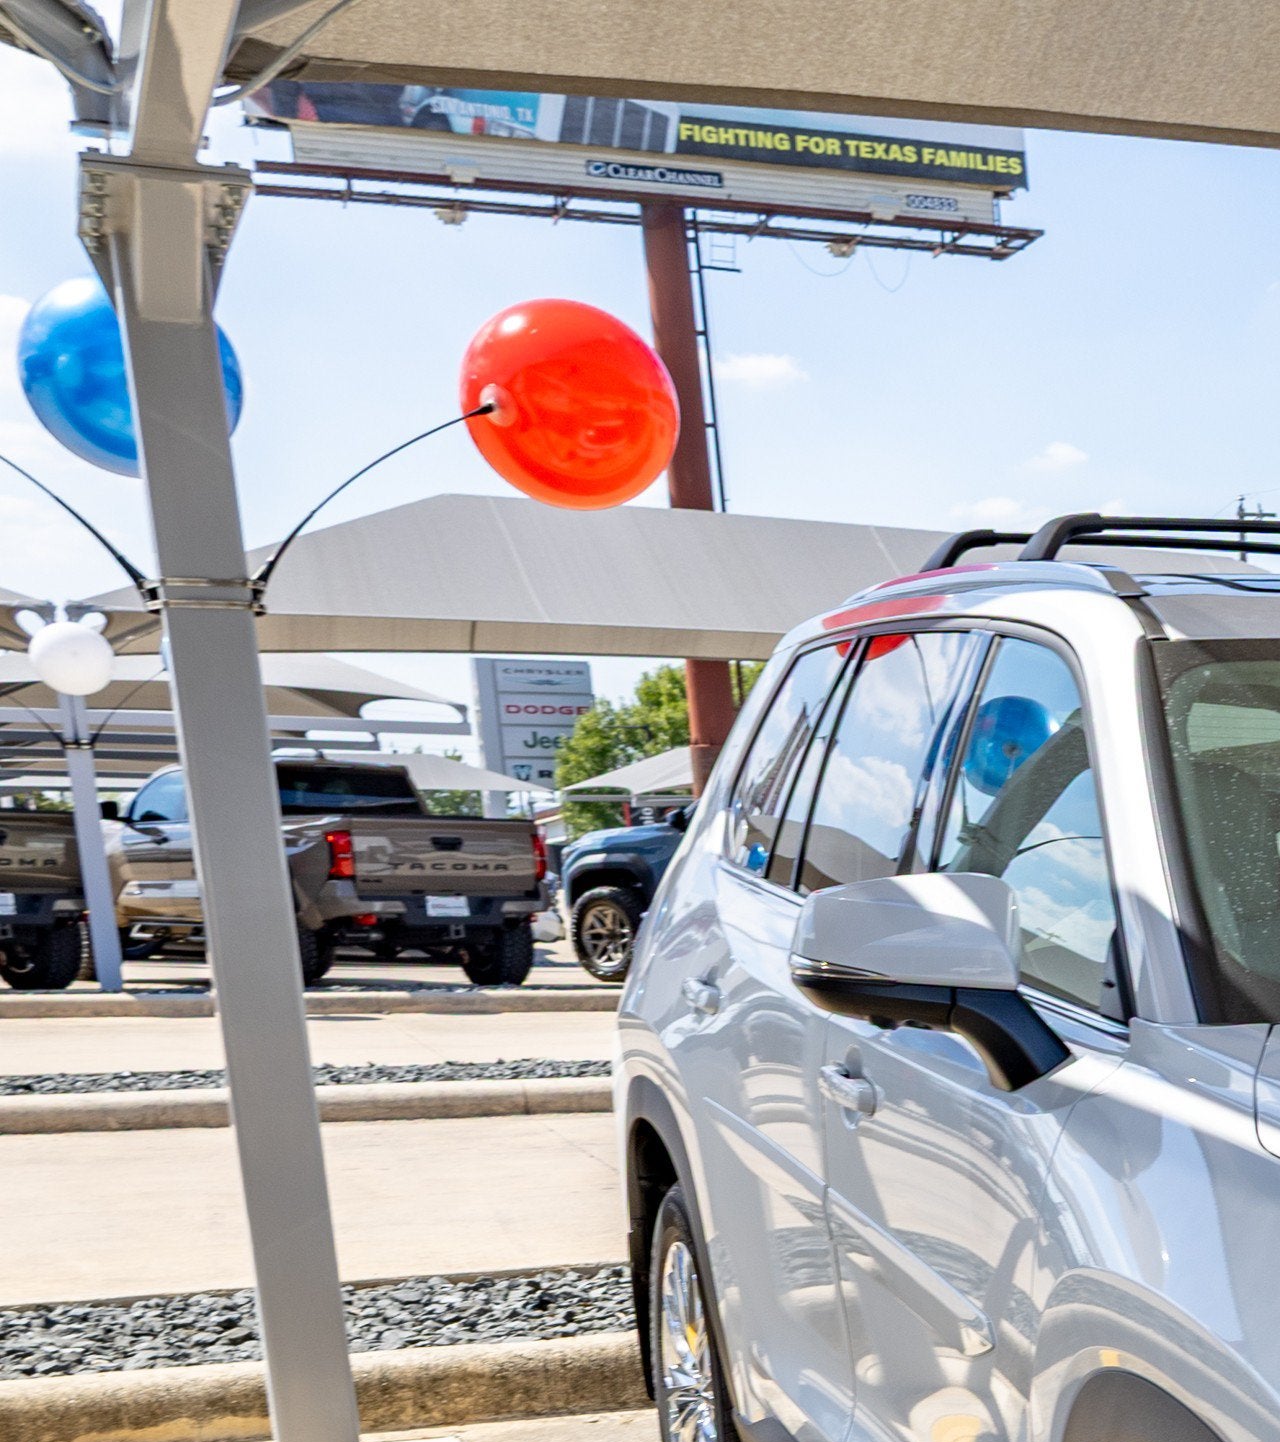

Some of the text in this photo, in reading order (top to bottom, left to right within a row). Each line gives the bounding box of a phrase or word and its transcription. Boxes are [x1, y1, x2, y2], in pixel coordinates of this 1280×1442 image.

[516, 107, 533, 122] TX
[679, 123, 1023, 175] FIGHTING FOR TEXAS FAMILIES
[502, 667, 584, 676] CHRYSLER
[505, 704, 590, 715] DODGE
[524, 731, 572, 750] Jee
[389, 862, 510, 871] TACOMA
